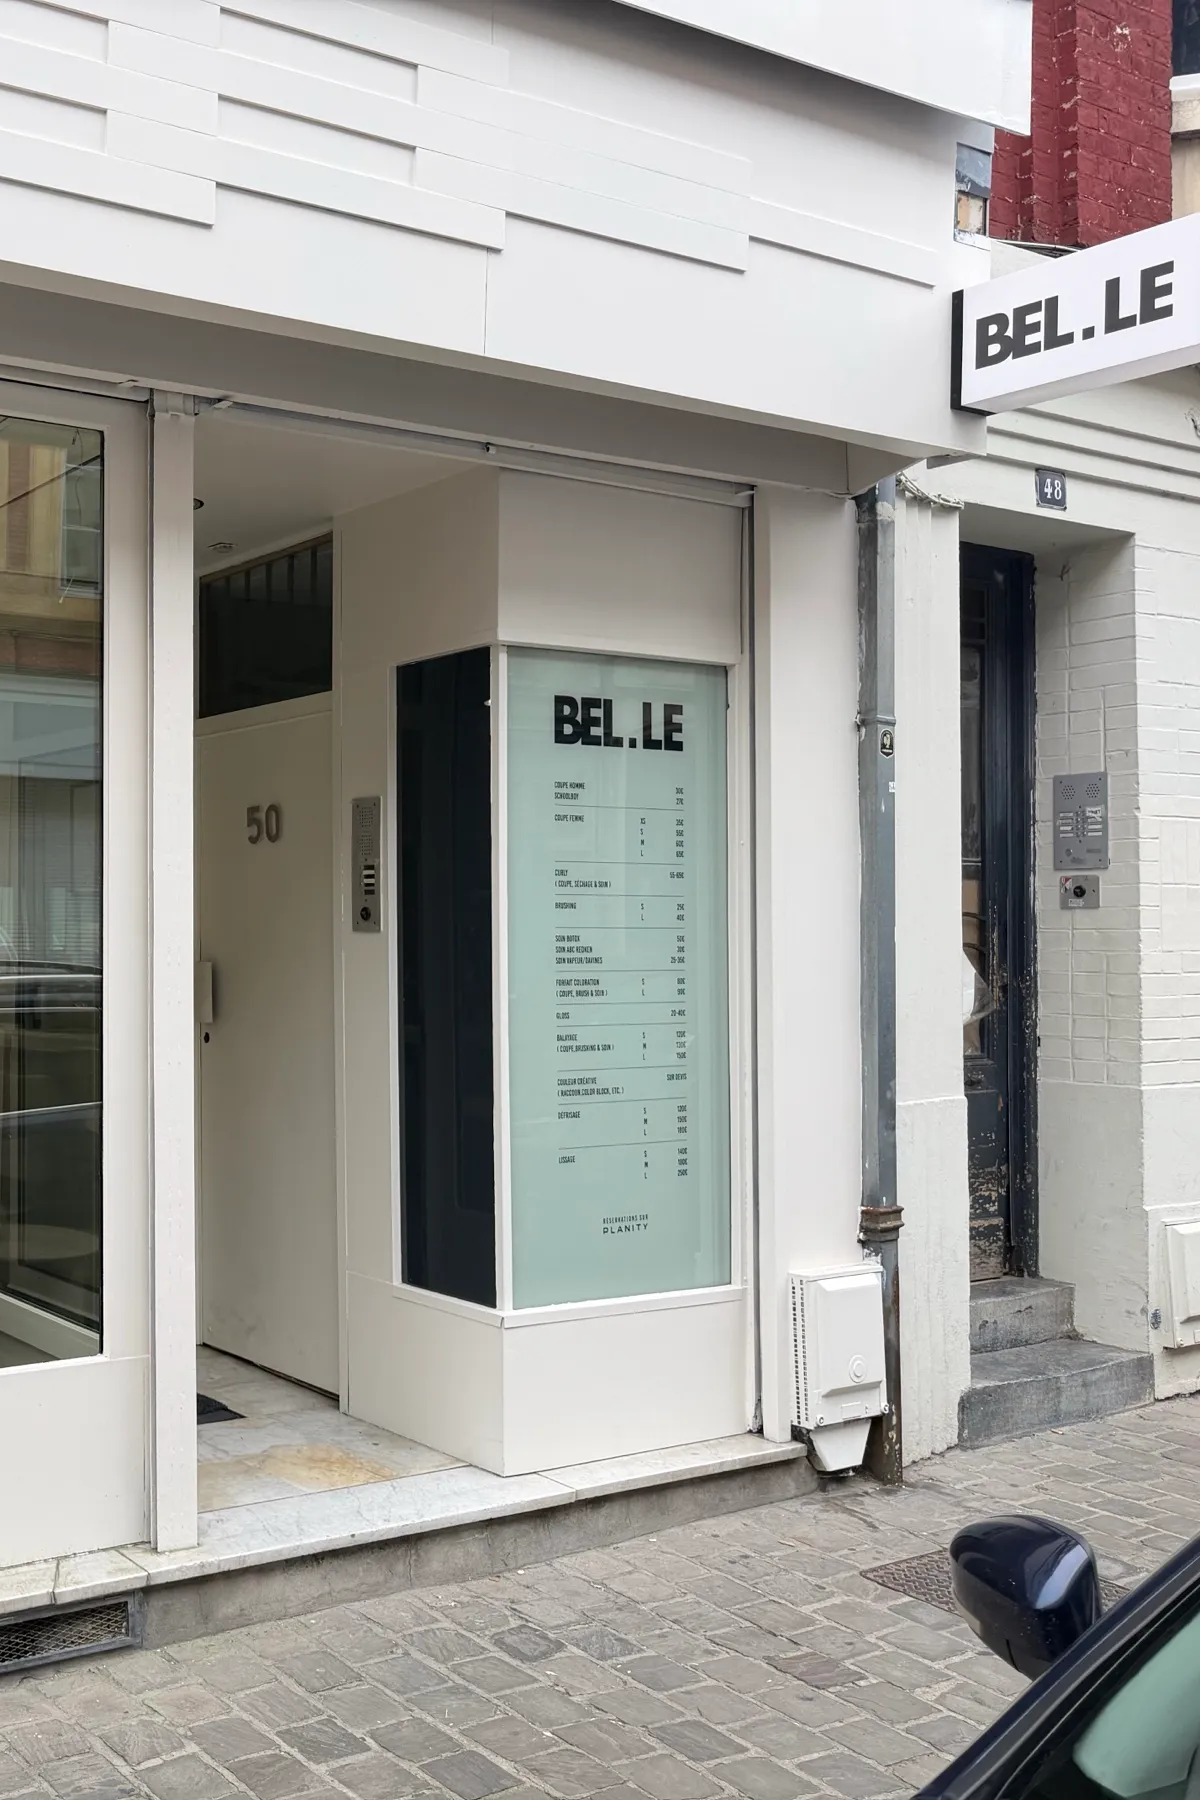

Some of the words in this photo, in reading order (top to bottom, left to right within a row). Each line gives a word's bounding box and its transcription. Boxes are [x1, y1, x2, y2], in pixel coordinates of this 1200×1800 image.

[1044, 478, 1062, 500] 48
[554, 781, 568, 789] COUPE
[554, 792, 579, 800] SCHOOLBOY
[569, 814, 584, 822] FEMME
[246, 804, 280, 844] 50
[555, 869, 568, 877] CURLY
[574, 878, 593, 888] SÉCHAGE
[555, 902, 577, 910] BRUSHING
[556, 1034, 578, 1042] BALAYAGE
[557, 1078, 577, 1086] COULEUR
[577, 1076, 597, 1085] CRÉATIVE
[666, 1073, 675, 1081] SUR
[558, 1110, 581, 1119] DÉFRISAGE
[558, 1155, 576, 1164] LISSAGE
[603, 1214, 638, 1224] RÉSERVATIONS
[602, 1223, 649, 1235] PLANITY
